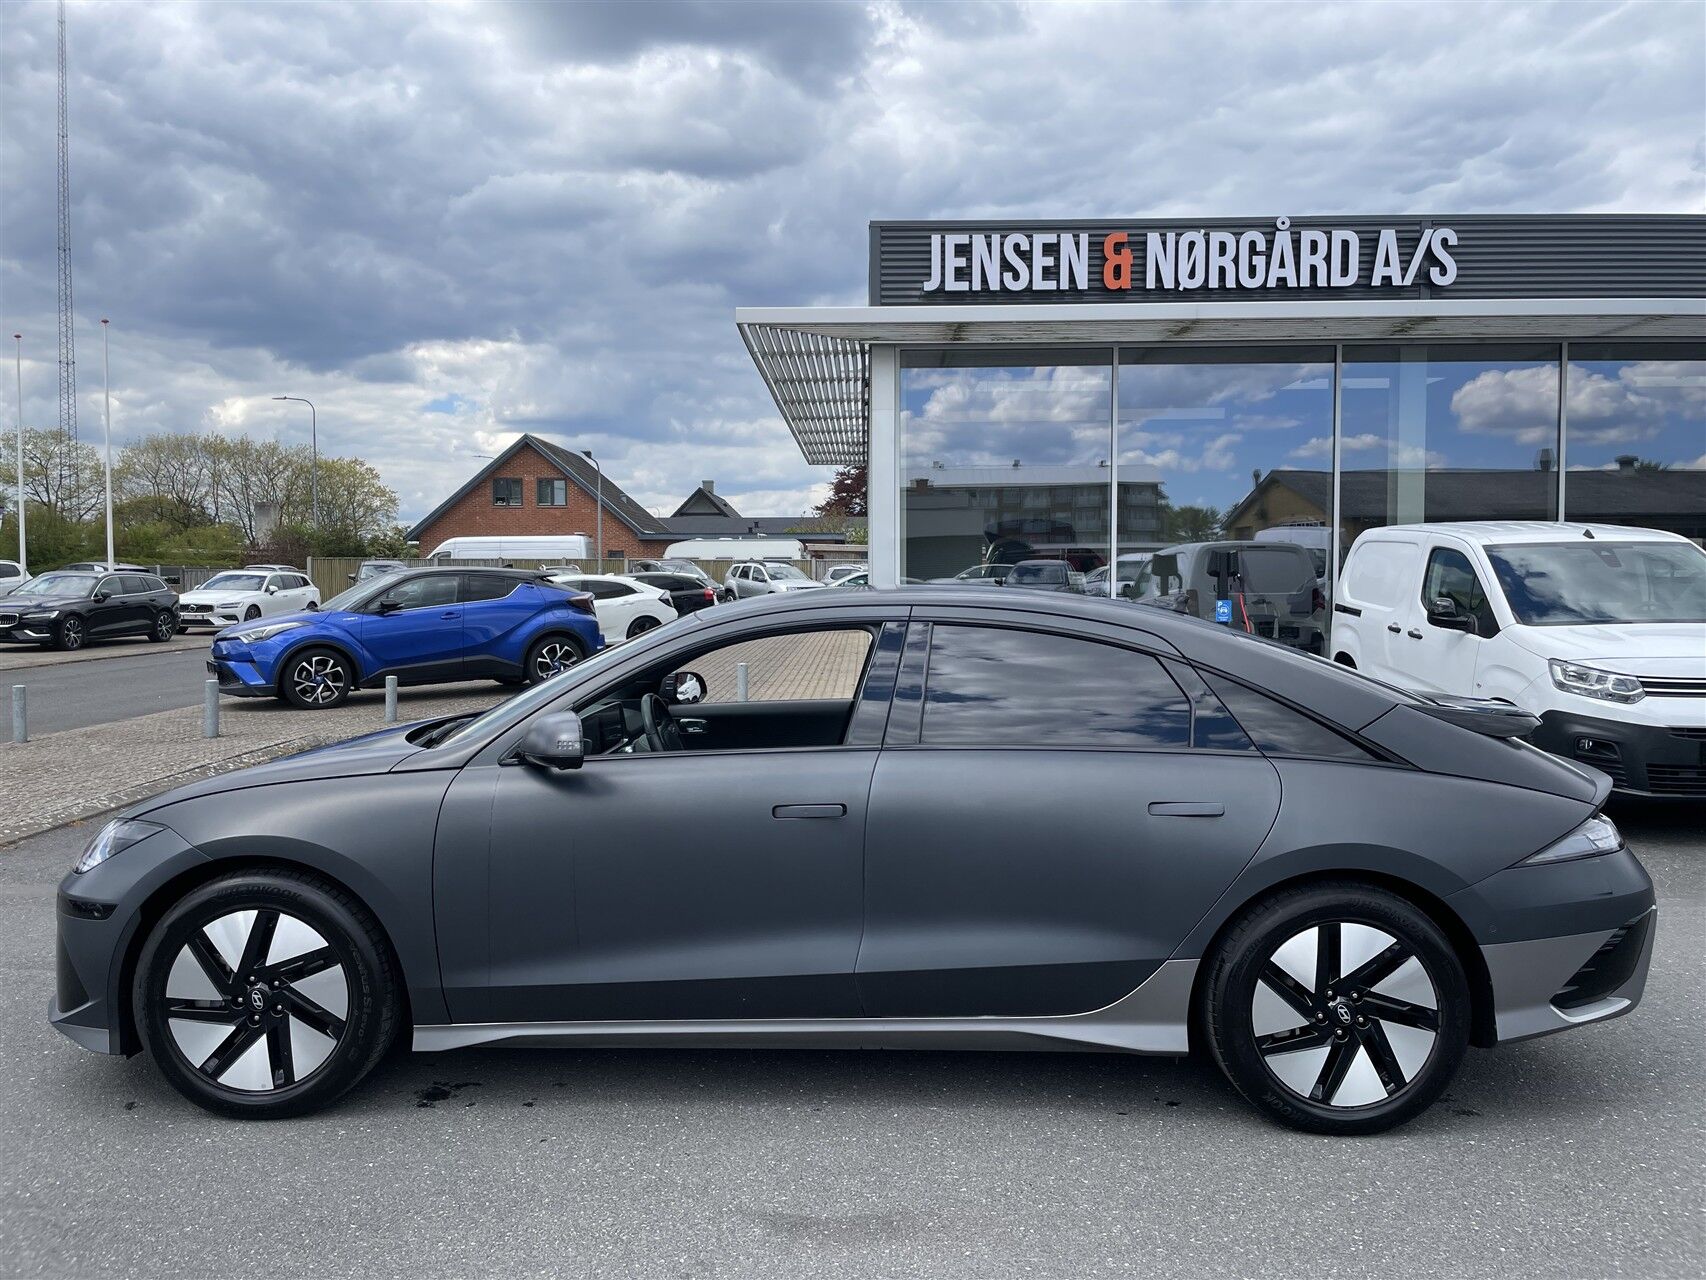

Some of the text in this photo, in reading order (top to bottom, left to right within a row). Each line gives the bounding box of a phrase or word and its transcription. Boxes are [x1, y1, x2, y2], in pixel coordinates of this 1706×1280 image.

[923, 216, 1458, 291] JENSEN & NØRGÅRD A/S
